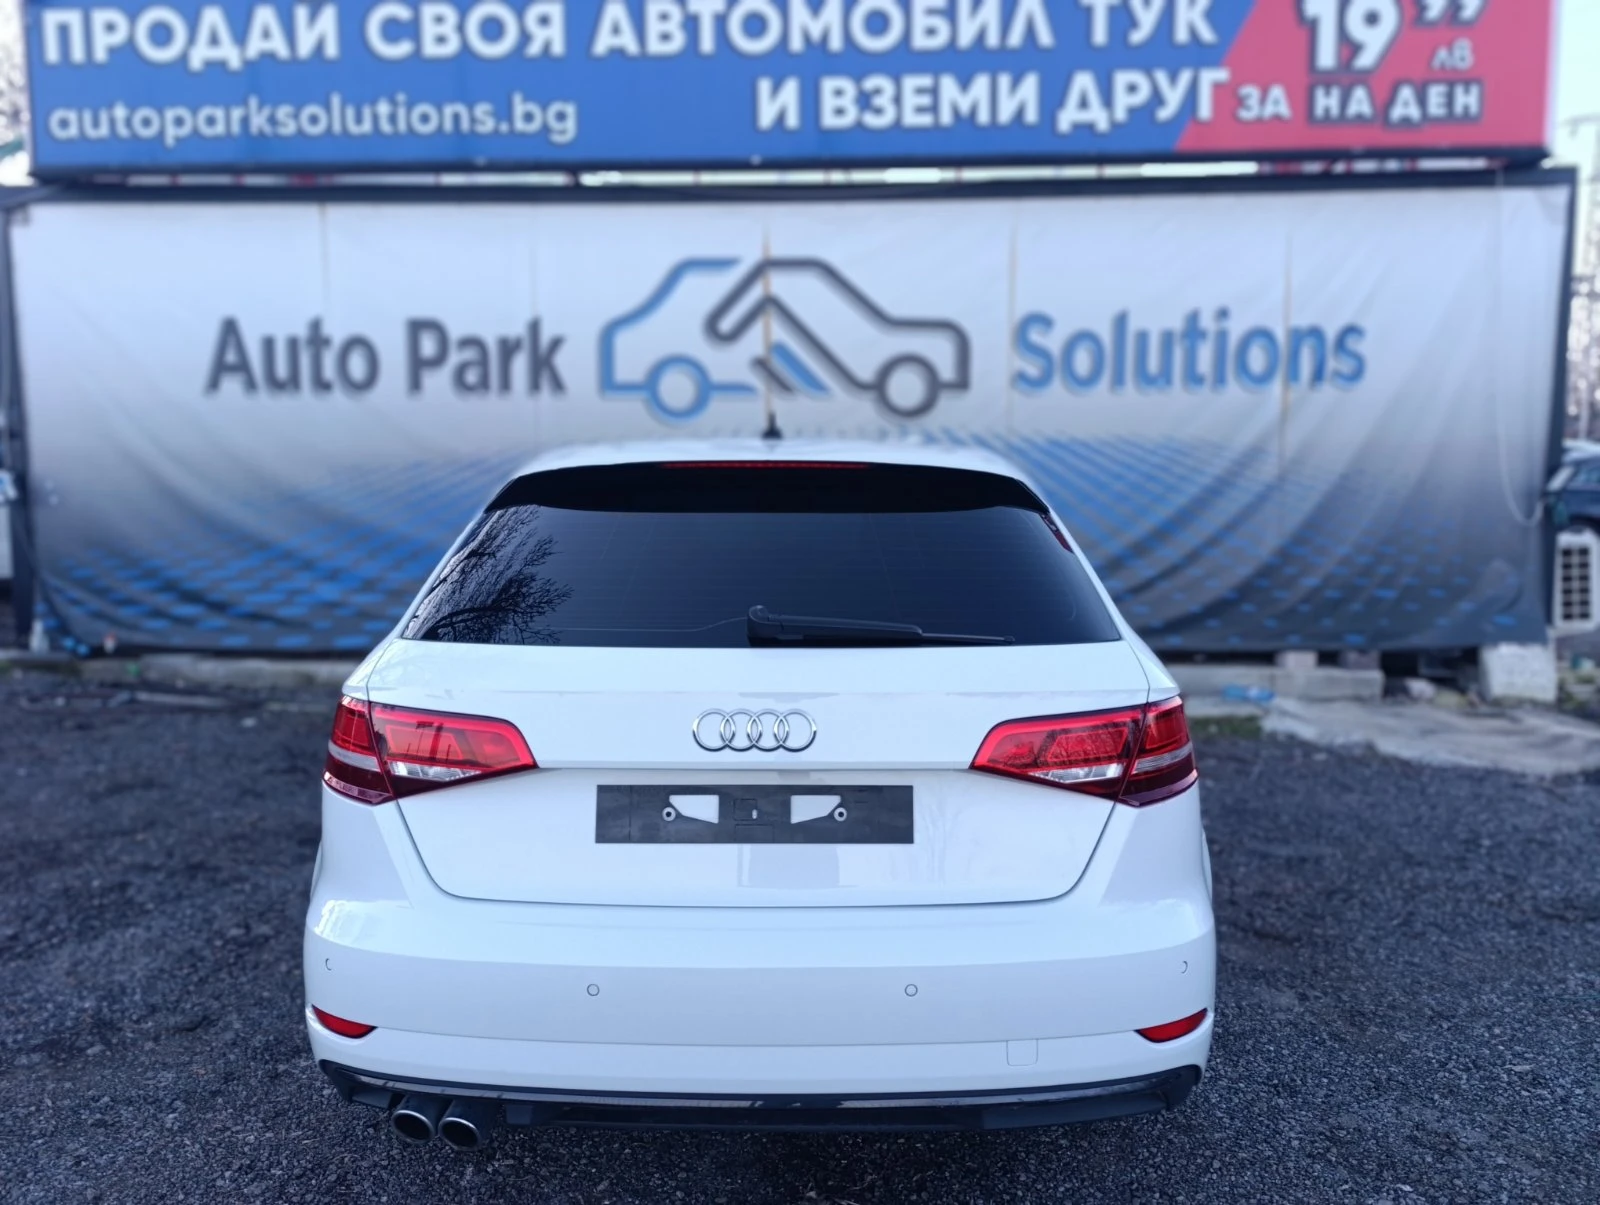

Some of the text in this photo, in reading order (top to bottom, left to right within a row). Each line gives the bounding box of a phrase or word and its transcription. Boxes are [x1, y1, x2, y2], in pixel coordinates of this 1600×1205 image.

[364, 2, 567, 60] СВОЯ
[591, 0, 1055, 57] АВТОМОБИЛ
[1080, 0, 1218, 47] ТУК
[48, 92, 578, 146] autoparksolutions.bg
[755, 67, 1482, 134] И ВЗЕМИ ДРУГ ЗА НА ДЕН
[206, 316, 567, 396] Auto Park
[1012, 306, 1367, 391] Solutions
